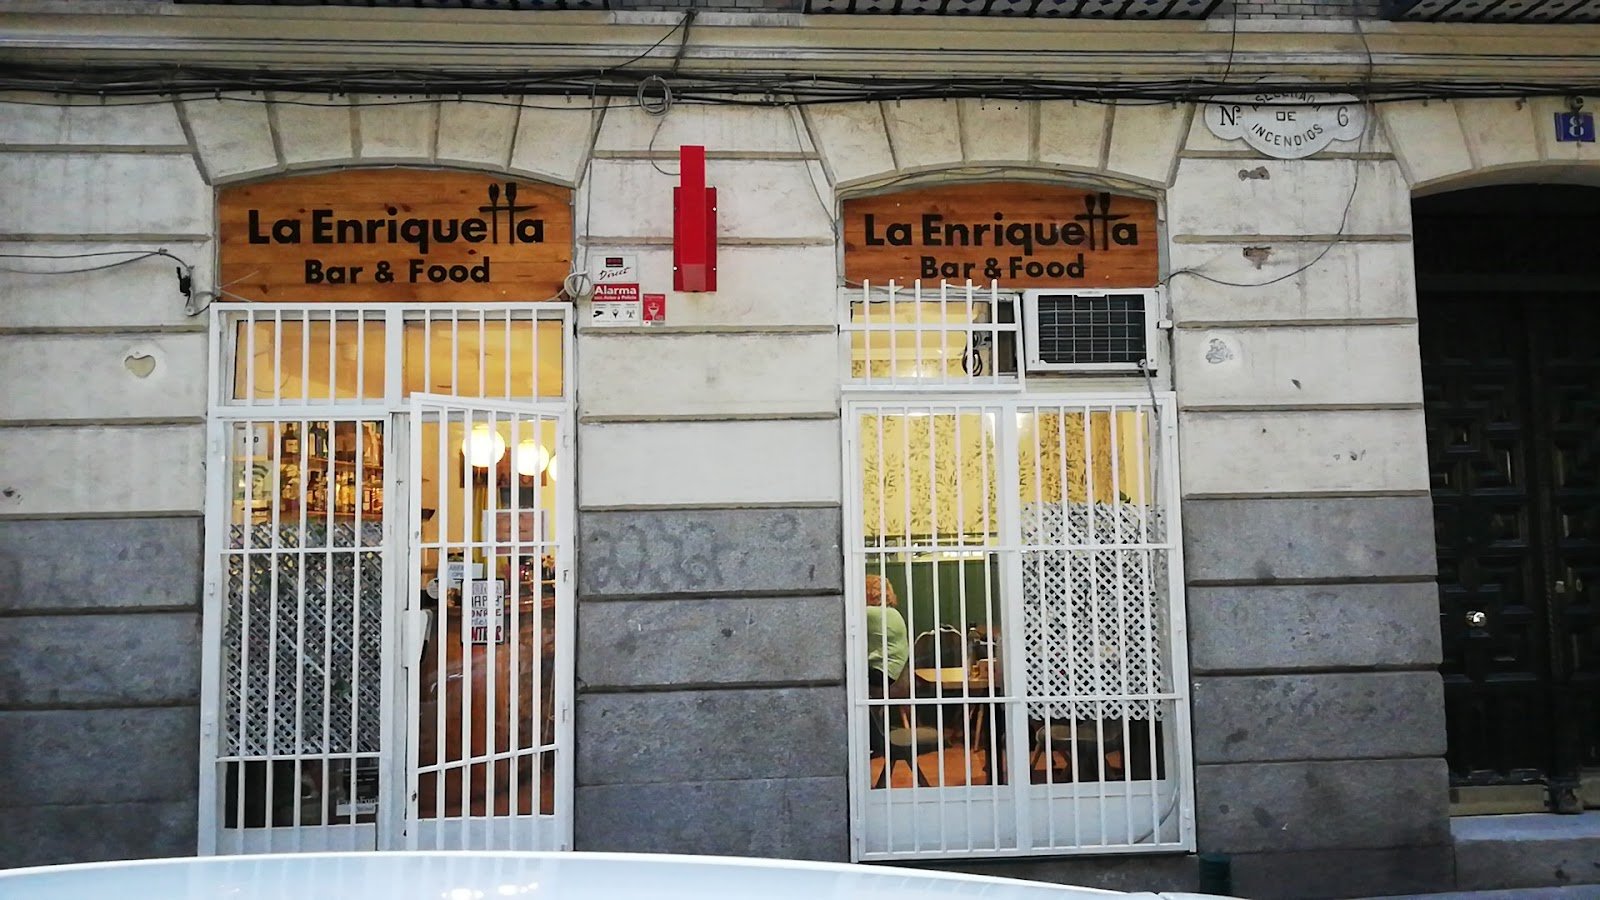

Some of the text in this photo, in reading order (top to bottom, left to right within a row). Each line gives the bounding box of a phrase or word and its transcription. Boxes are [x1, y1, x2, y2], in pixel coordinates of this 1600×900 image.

[1276, 111, 1296, 121] DE
[1337, 106, 1349, 127] 6
[1569, 115, 1584, 137] 8
[1251, 123, 1323, 147] INCENDIOS
[248, 183, 544, 254] La Enriquetta
[864, 192, 1138, 256] La Enriquetta
[305, 256, 490, 284] Bar & Food
[920, 253, 1085, 280] Bar & Food
[594, 285, 638, 295] Alarma
